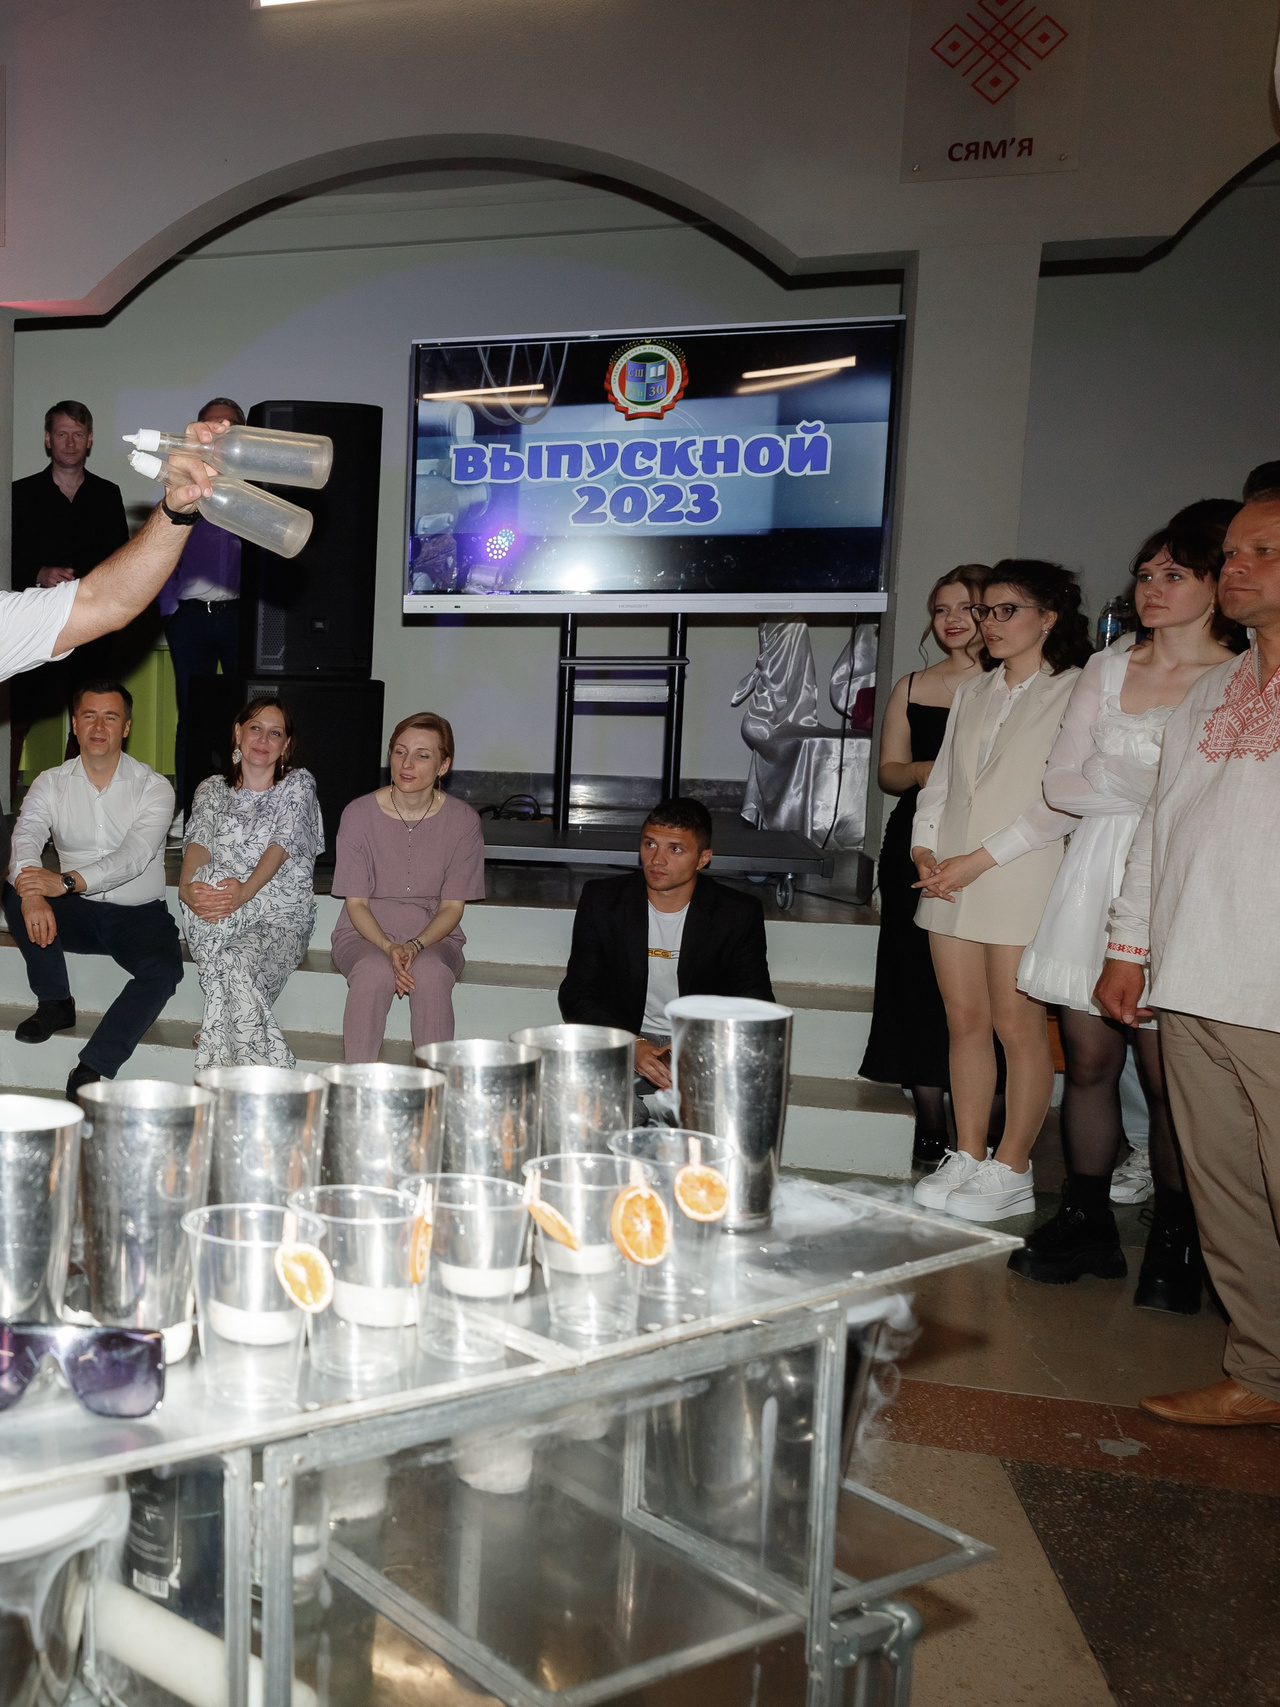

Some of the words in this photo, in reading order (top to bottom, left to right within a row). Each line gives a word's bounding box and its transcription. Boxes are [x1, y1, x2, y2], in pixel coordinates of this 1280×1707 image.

[947, 137, 1034, 162] СЯМ'Я
[648, 384, 664, 397] 30
[451, 420, 831, 484] ВЫПУСКНОЙ
[570, 482, 721, 527] 2023
